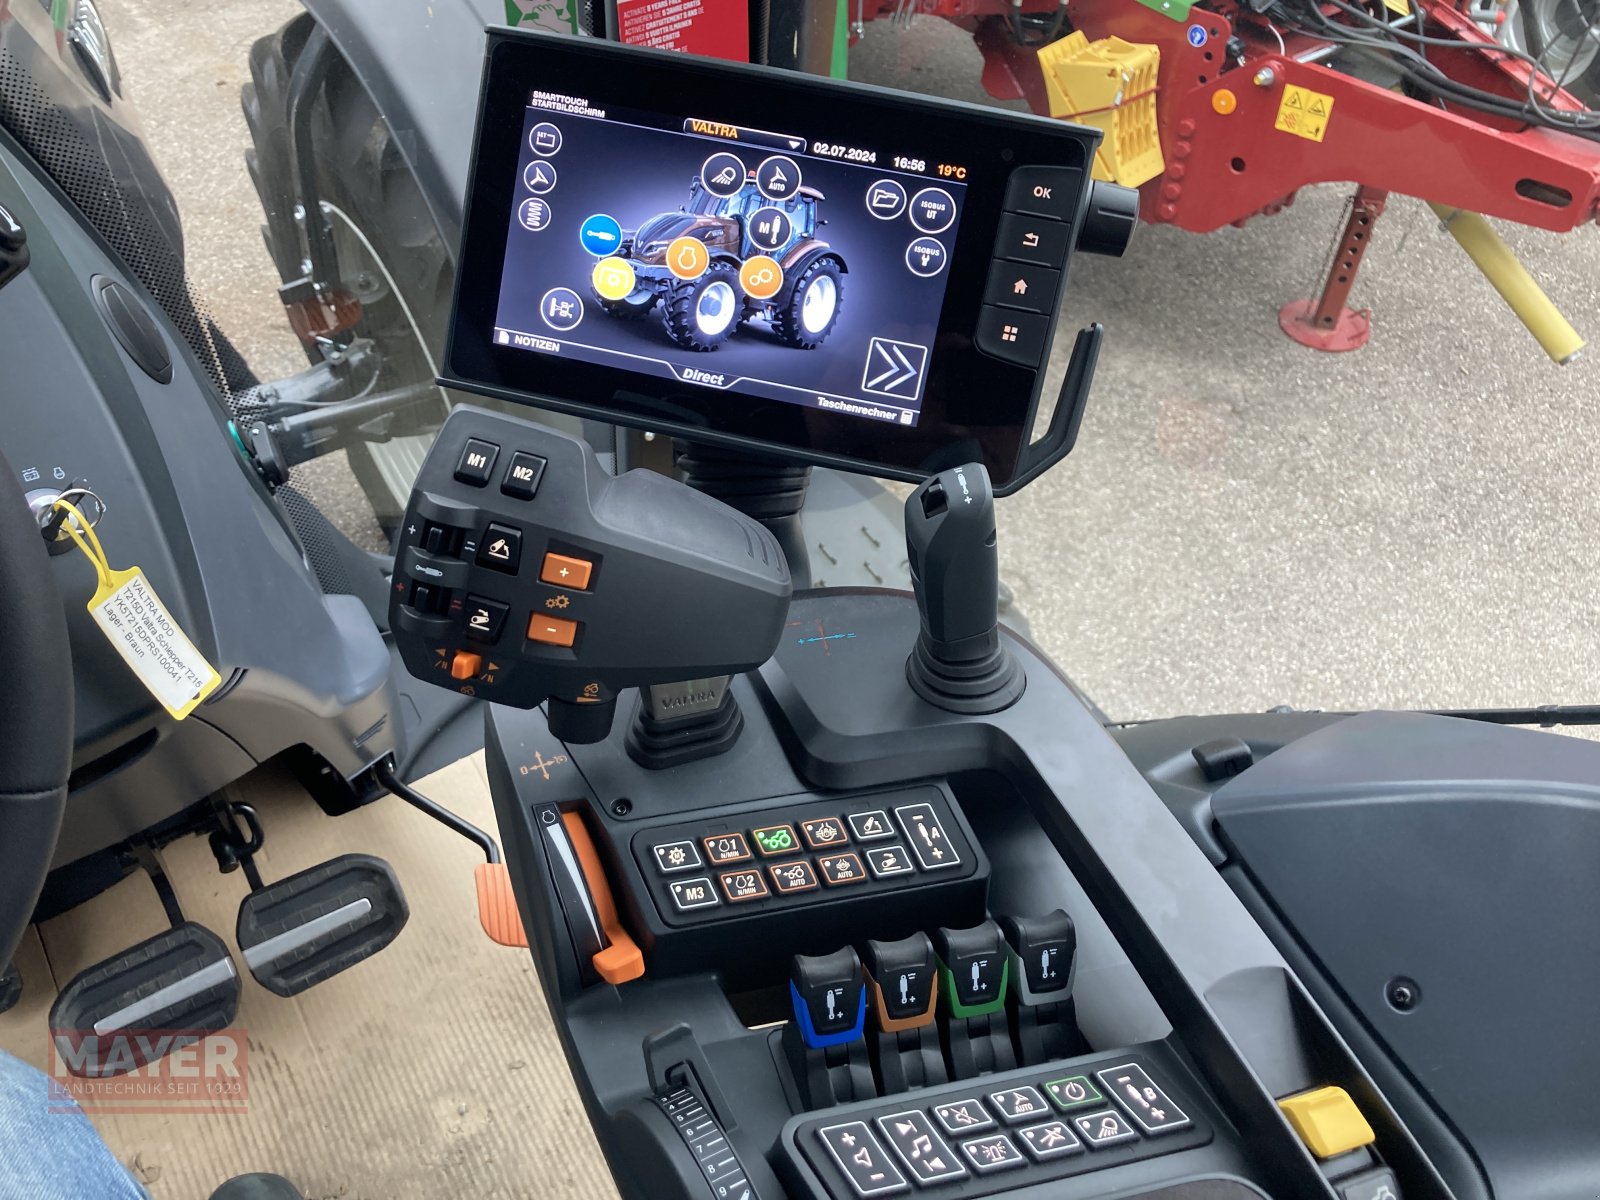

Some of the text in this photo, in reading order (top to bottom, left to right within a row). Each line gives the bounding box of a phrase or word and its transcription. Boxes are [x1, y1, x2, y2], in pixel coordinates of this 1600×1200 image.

[533, 91, 588, 107] SMARTTOUCH
[532, 99, 605, 118] STARTBILDSCHIRM
[692, 120, 738, 139] VALTRA
[814, 142, 967, 179] 02.07.2024 16:56 19°C
[769, 182, 786, 192] AUTO
[1033, 186, 1052, 200] OK
[921, 201, 946, 211] ISOBUS
[927, 210, 937, 220] UT
[759, 222, 770, 234] M
[915, 246, 940, 257] ISOBUS
[514, 335, 561, 353] NOTIZEN
[683, 368, 725, 386] Direct
[818, 397, 898, 420] Taschenrechner
[467, 454, 487, 469] M1
[513, 466, 534, 481] M2
[133, 580, 175, 637] VALTRA MOD
[104, 603, 123, 629] Lager
[125, 633, 145, 659] Braun
[123, 587, 203, 689] T215D Valtra Schlepper T215
[931, 827, 941, 839] A
[730, 839, 737, 850] 1
[721, 851, 739, 859] N/MIN
[838, 870, 853, 879] AUTO
[747, 875, 755, 887] 2
[790, 879, 806, 887] AUTO
[686, 887, 705, 900] M3
[738, 887, 757, 896] N/MIN
[1143, 1087, 1157, 1100] B
[1015, 1103, 1033, 1113] AUTO
[686, 1128, 694, 1136] 6
[696, 1144, 703, 1153] 7
[708, 1164, 715, 1173] 8
[719, 1186, 727, 1197] 9
